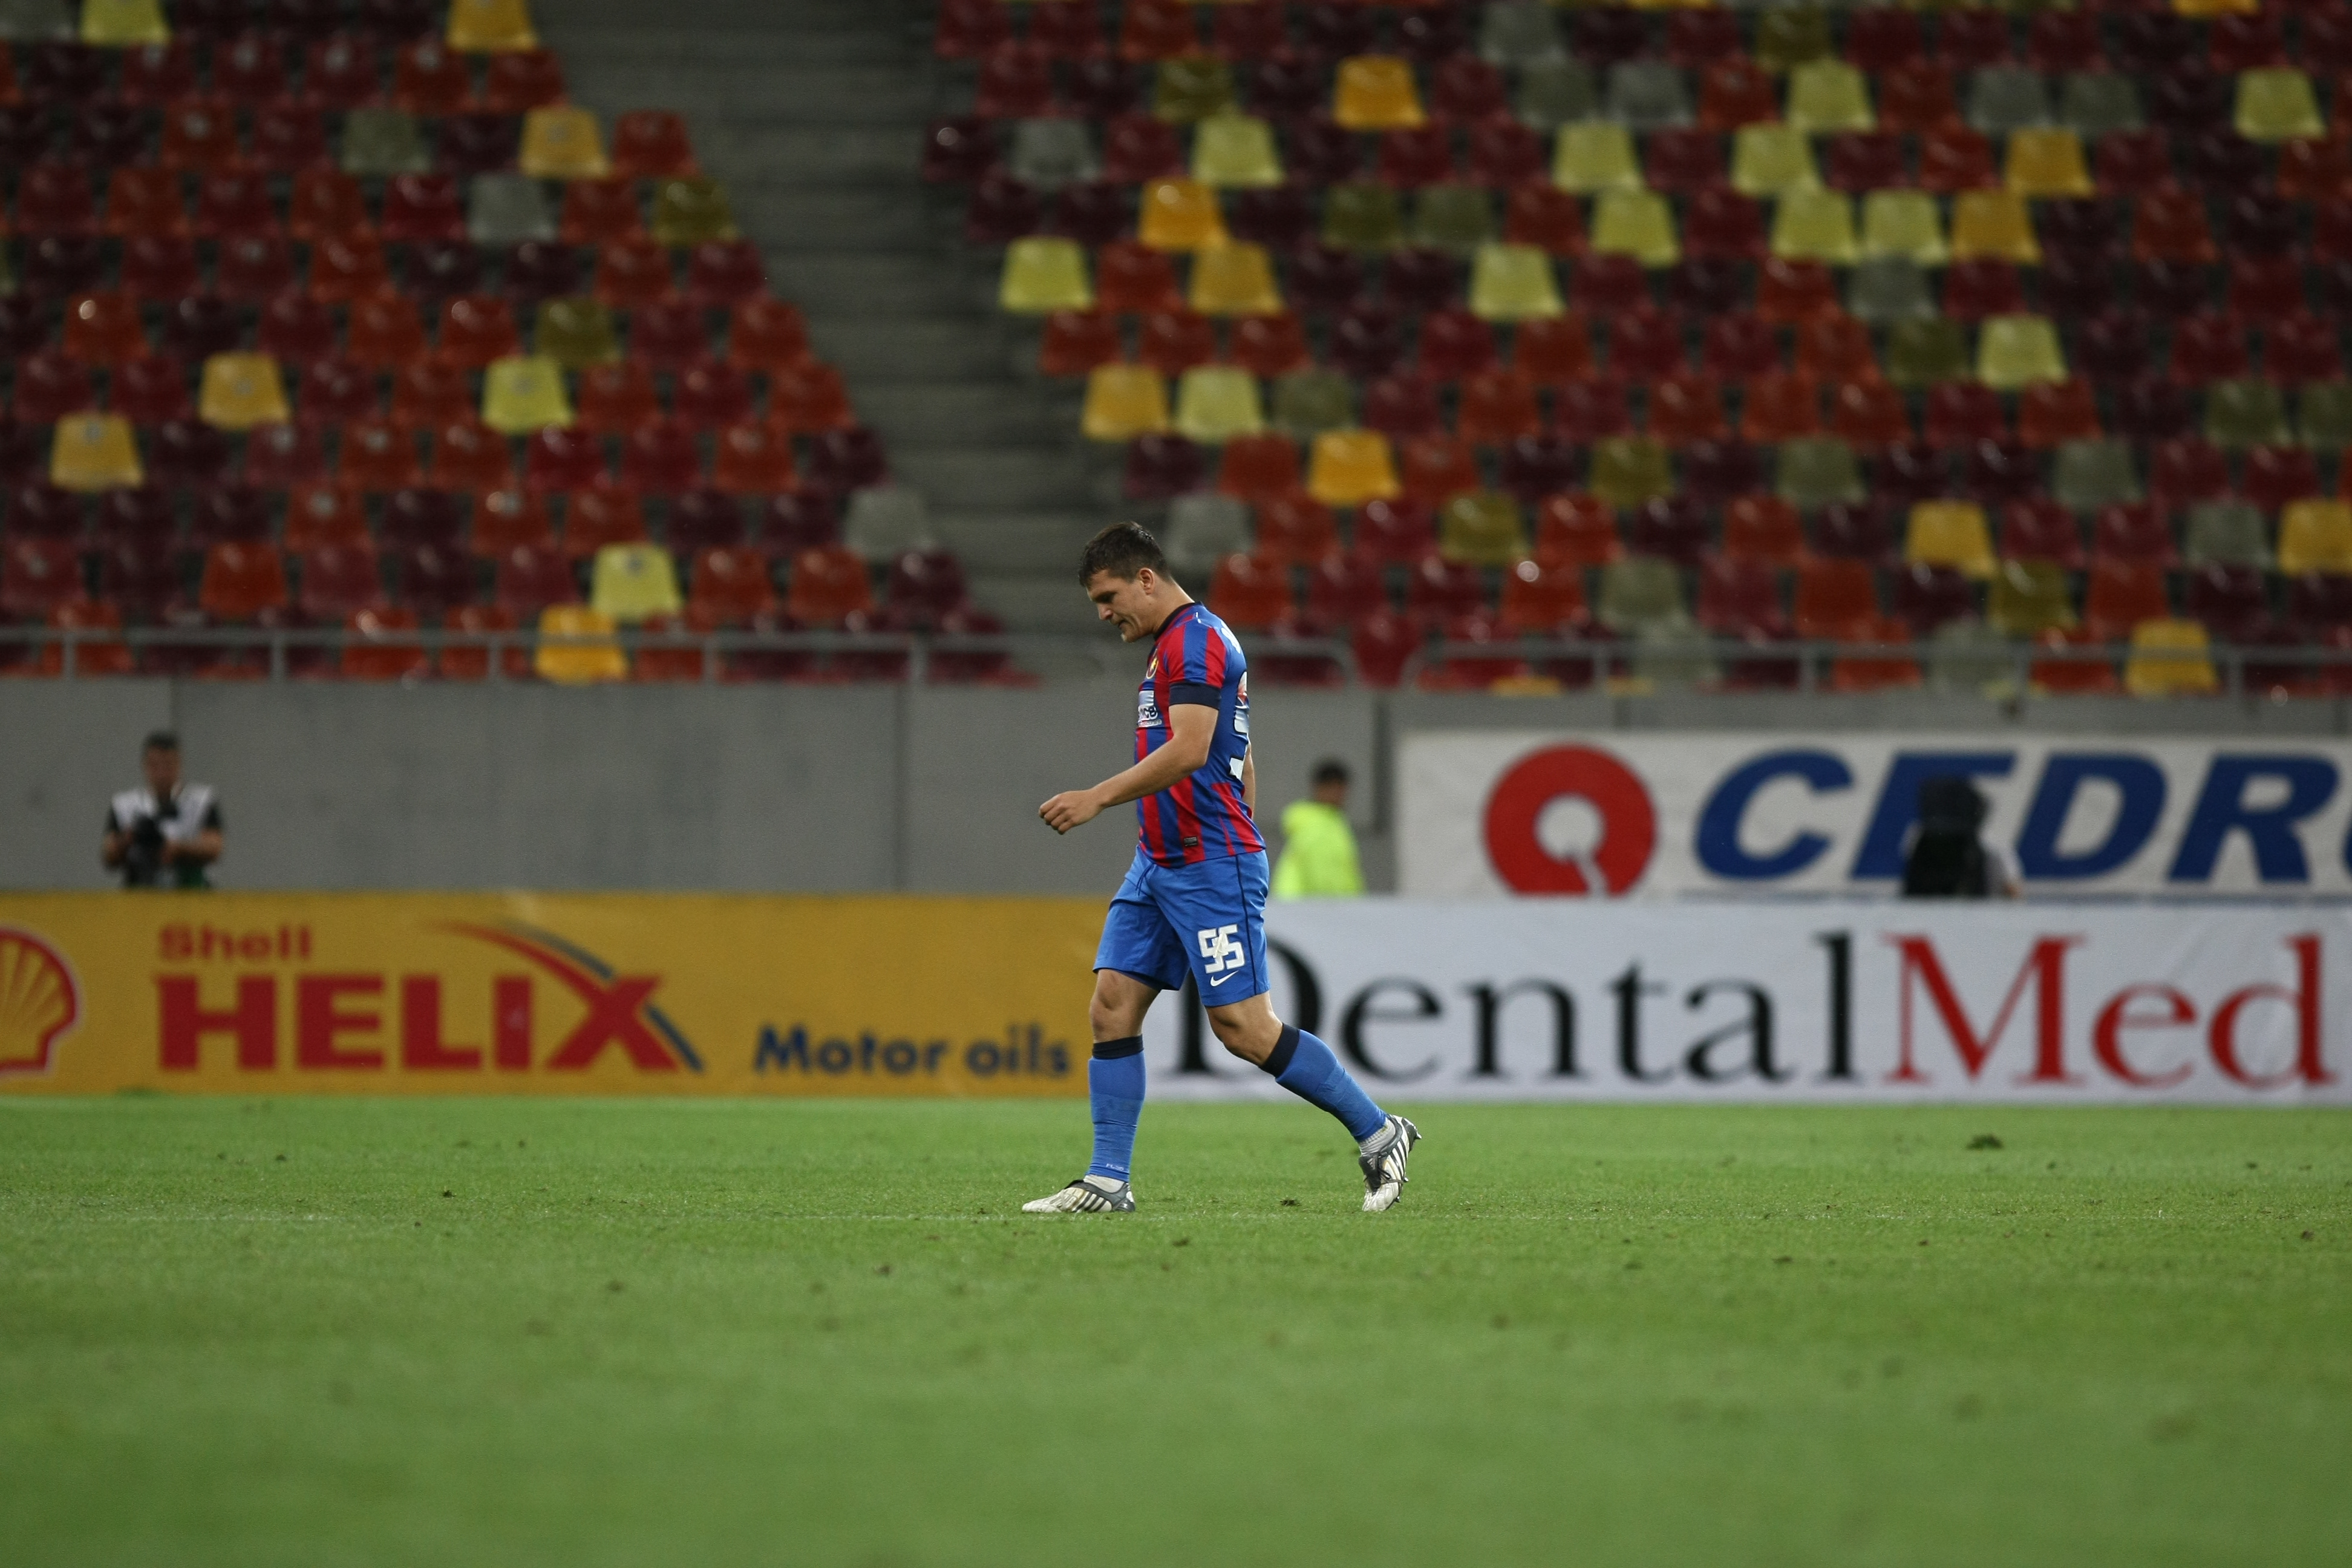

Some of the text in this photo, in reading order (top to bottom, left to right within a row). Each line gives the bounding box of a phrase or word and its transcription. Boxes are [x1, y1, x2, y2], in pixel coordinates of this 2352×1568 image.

[1693, 749, 2352, 883] CEDR
[160, 923, 312, 960] Shell
[156, 974, 682, 1071] HELIX
[754, 1022, 1071, 1076] Motor oils
